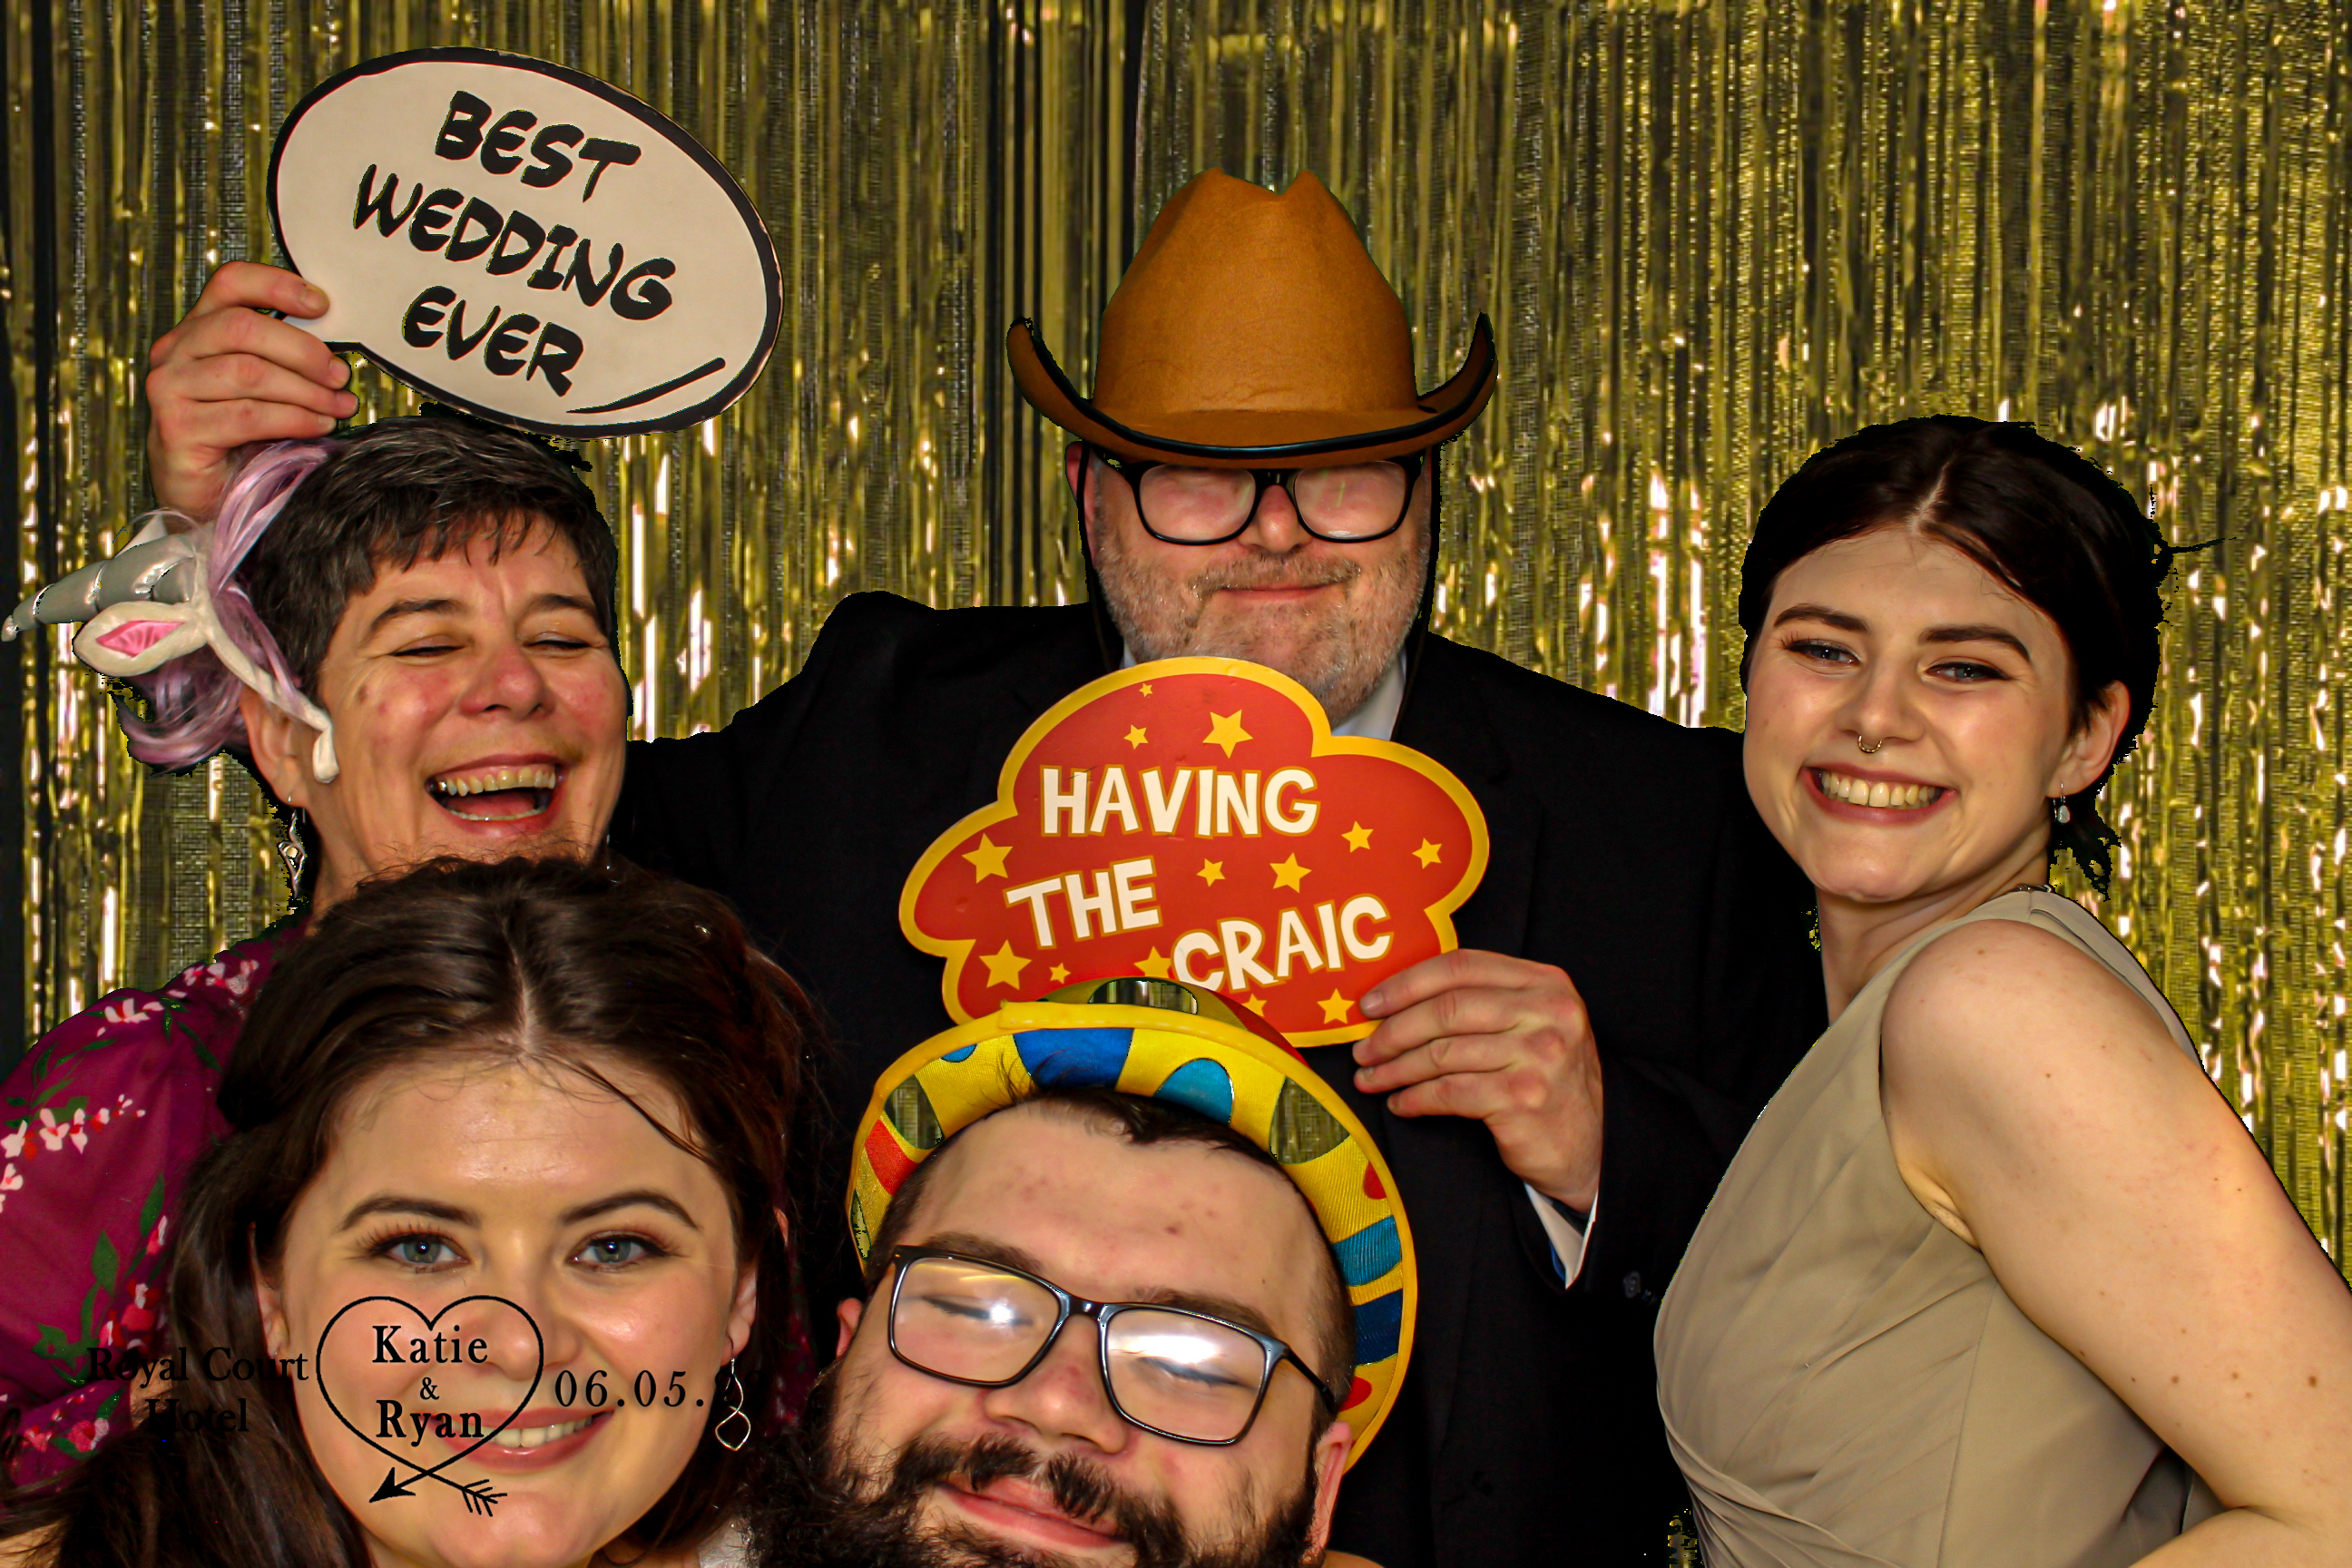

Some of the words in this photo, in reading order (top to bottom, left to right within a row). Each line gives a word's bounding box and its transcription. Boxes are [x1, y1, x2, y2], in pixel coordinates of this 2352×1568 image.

[436, 91, 642, 202] BEST
[353, 164, 676, 320] WEDDING
[402, 286, 583, 397] EVER
[1039, 765, 1320, 838] HAVING
[1004, 856, 1162, 948] THE
[1171, 894, 1394, 992] CRAIC
